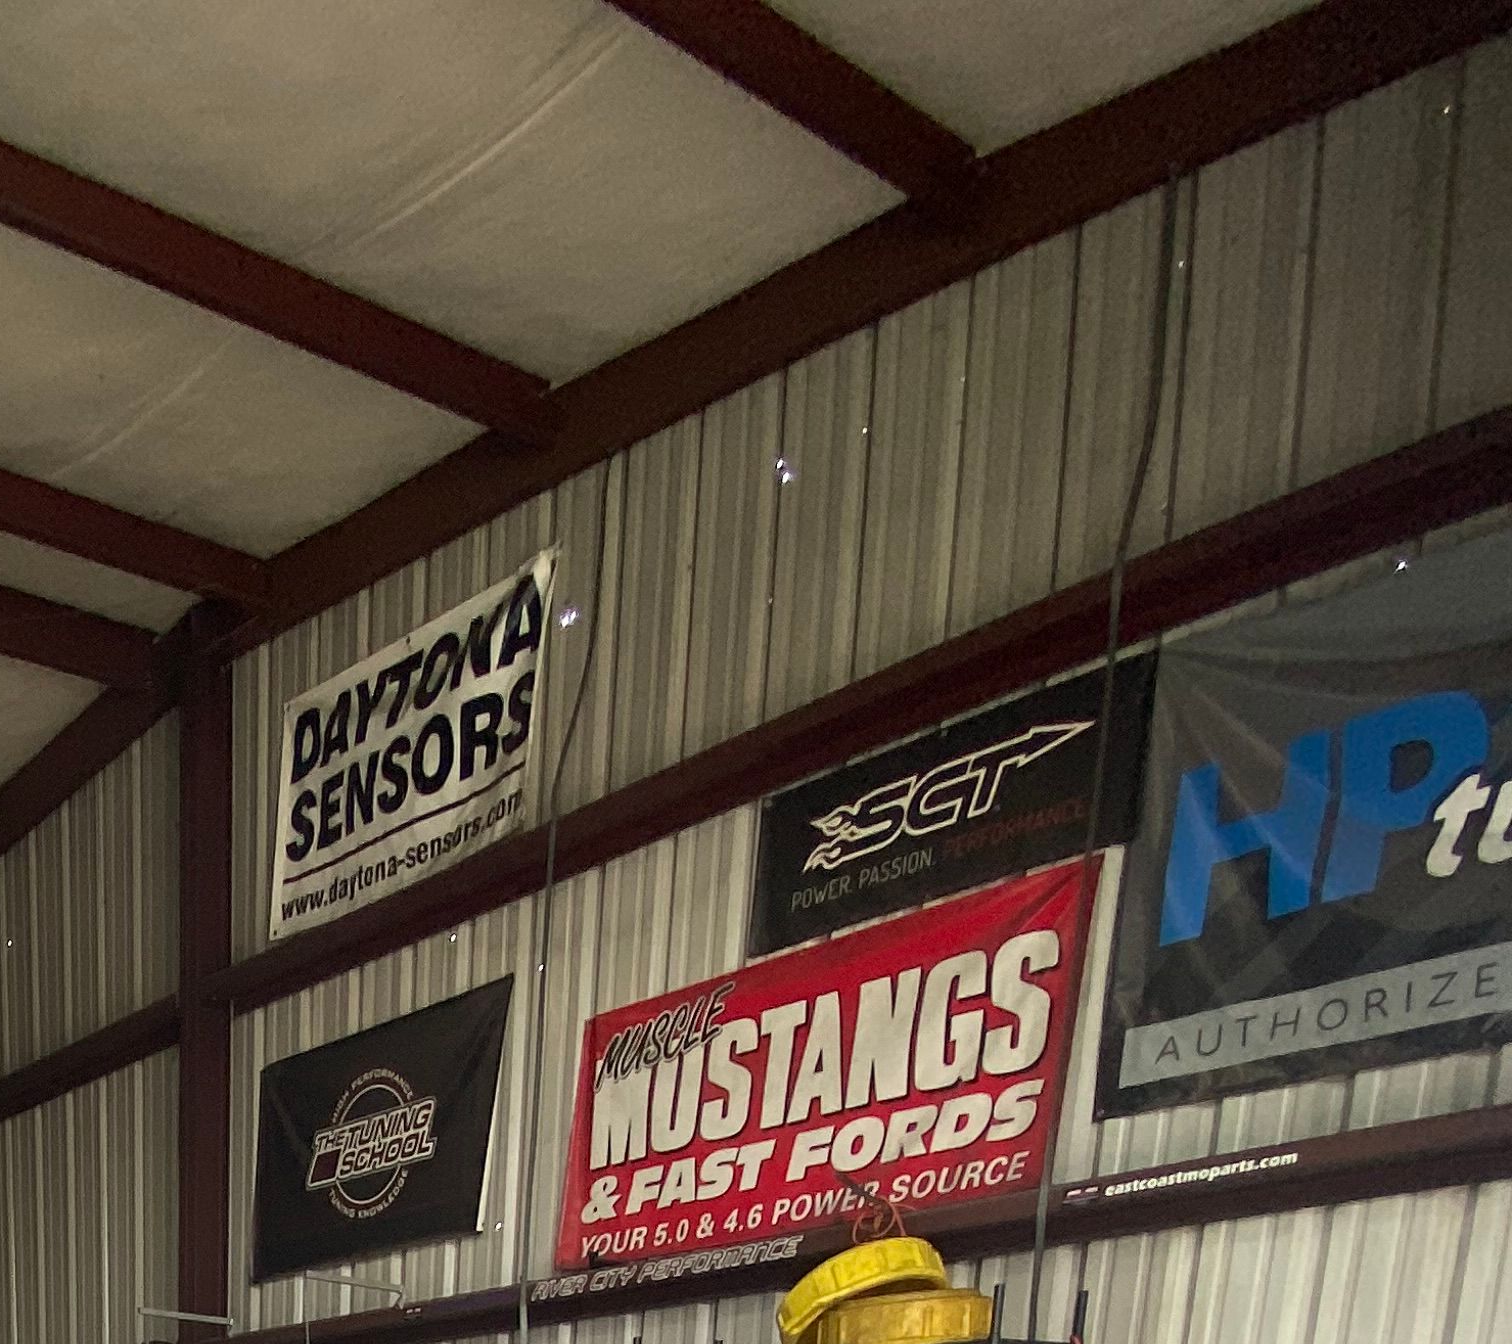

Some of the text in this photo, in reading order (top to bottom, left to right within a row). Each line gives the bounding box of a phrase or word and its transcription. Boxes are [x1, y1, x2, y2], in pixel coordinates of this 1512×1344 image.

[290, 574, 541, 785] DAYTONA
[286, 669, 535, 862] SENSORS
[803, 720, 1095, 874] SCT
[589, 930, 1060, 1171] MUSTANGS
[595, 983, 737, 1092] MUSCLE
[316, 1102, 432, 1153] THE TUNING
[339, 1129, 434, 1177] SCHOOL
[579, 1079, 1044, 1225] & FAST FORDS
[1104, 1152, 1299, 1197] eastcoastmoparts.com
[580, 1150, 1031, 1258] YOUR 5.0 & 4.6 POWER SOURCE
[531, 1234, 805, 1302] RIVER CITY PERFORMANCE
